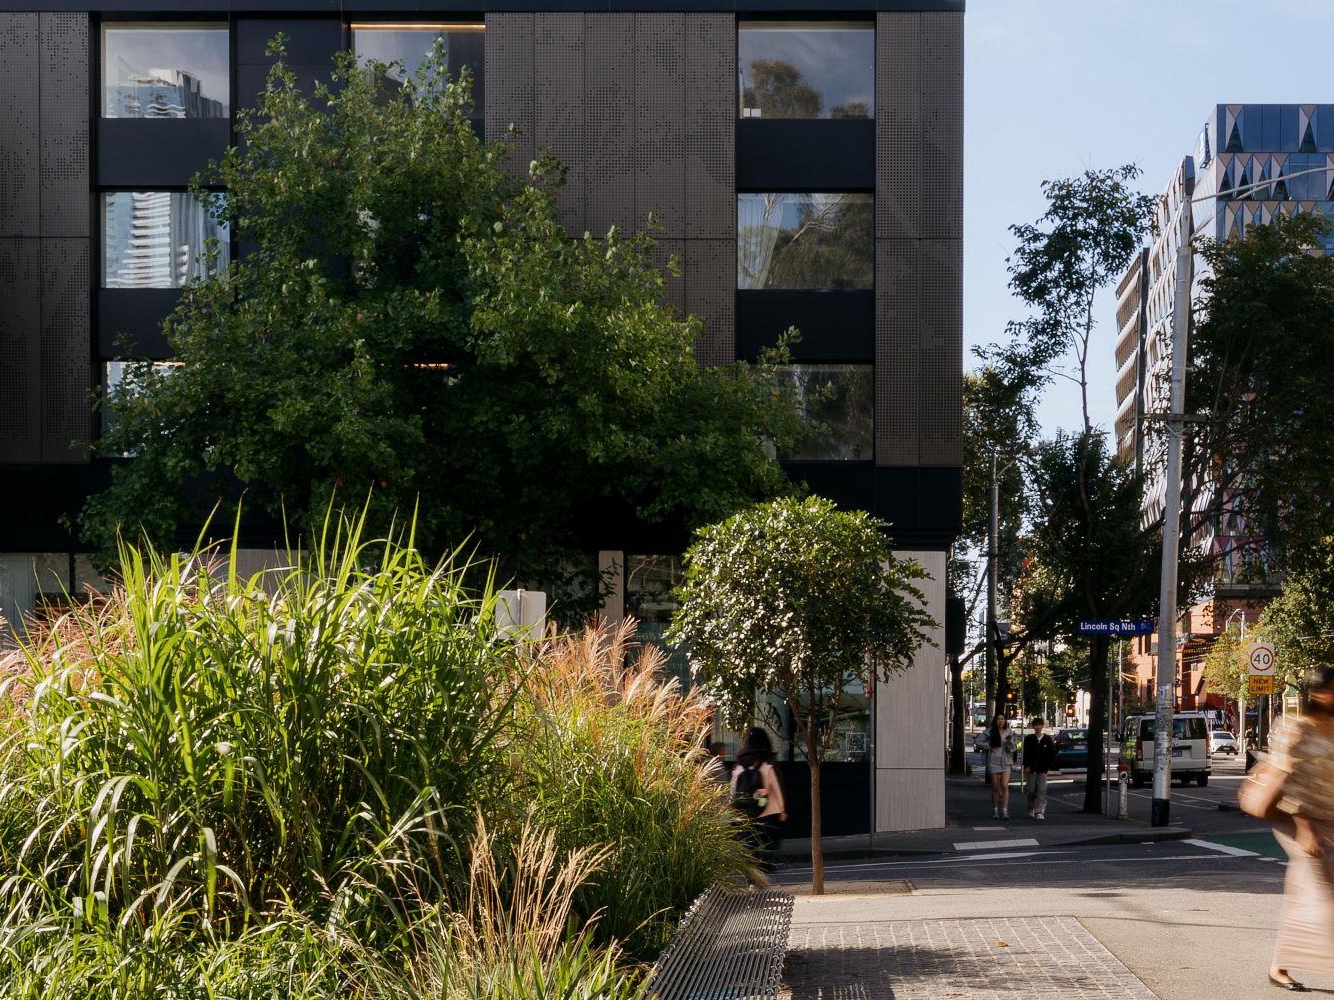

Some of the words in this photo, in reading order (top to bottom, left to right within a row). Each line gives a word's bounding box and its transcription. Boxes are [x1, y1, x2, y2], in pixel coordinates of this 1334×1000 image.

[1080, 622, 1108, 630] Lincoln
[1109, 622, 1120, 632] Sq
[1121, 622, 1136, 630] Nth
[1254, 654, 1270, 664] 40
